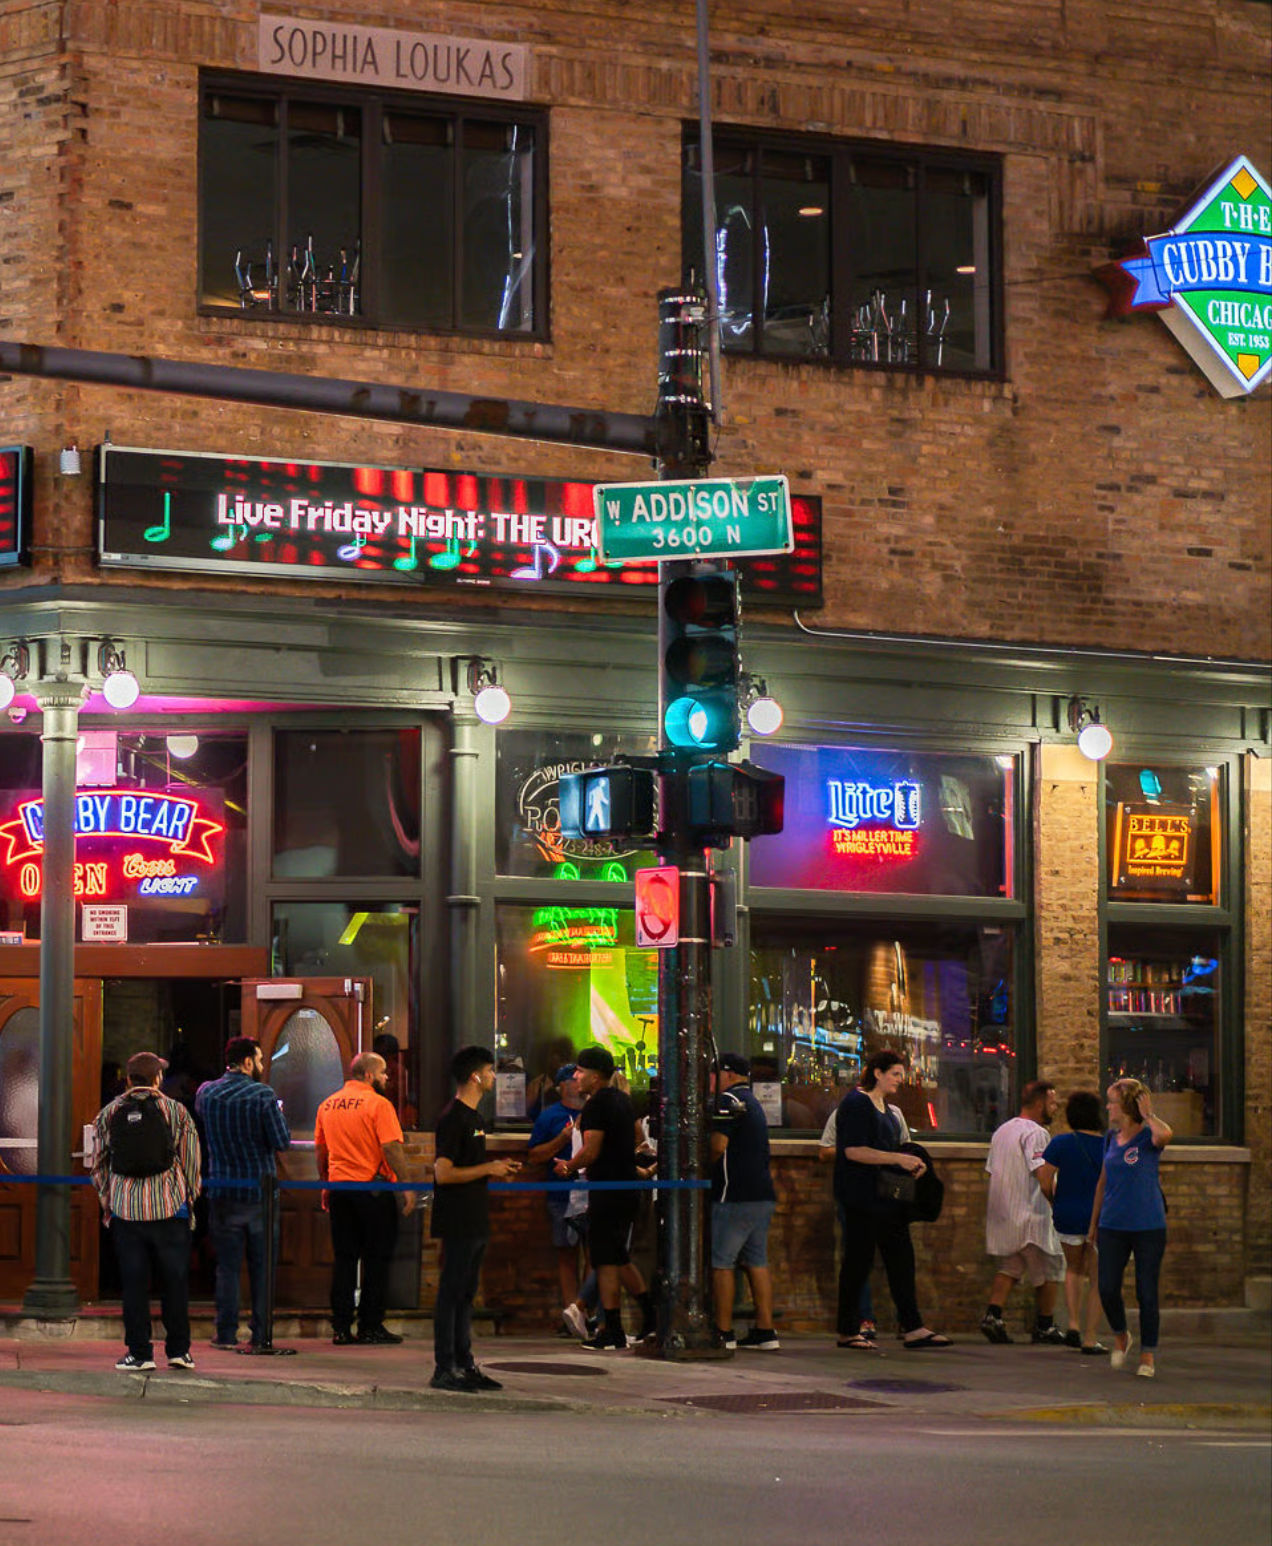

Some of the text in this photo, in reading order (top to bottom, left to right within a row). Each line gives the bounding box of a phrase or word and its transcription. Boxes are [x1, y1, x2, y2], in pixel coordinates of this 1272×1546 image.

[270, 25, 514, 90] SOPHIA LOUKAS
[1163, 240, 1251, 285] CUBBY
[1228, 332, 1246, 347] EST.
[217, 493, 285, 529] Live
[288, 498, 392, 534] Friday
[397, 507, 485, 540] Night:
[490, 512, 547, 544] THE
[606, 490, 778, 523] W ADDISON ST
[651, 525, 741, 548] 3600 N
[25, 796, 190, 840] CBY BEAR
[827, 780, 893, 828] Lite
[833, 829, 913, 842] IT'S MILLER TIME
[1130, 818, 1188, 833] BELL'S
[835, 841, 912, 855] WRIGLEYVILLE
[21, 863, 108, 895] OEN
[325, 1098, 364, 1111] STAFF
